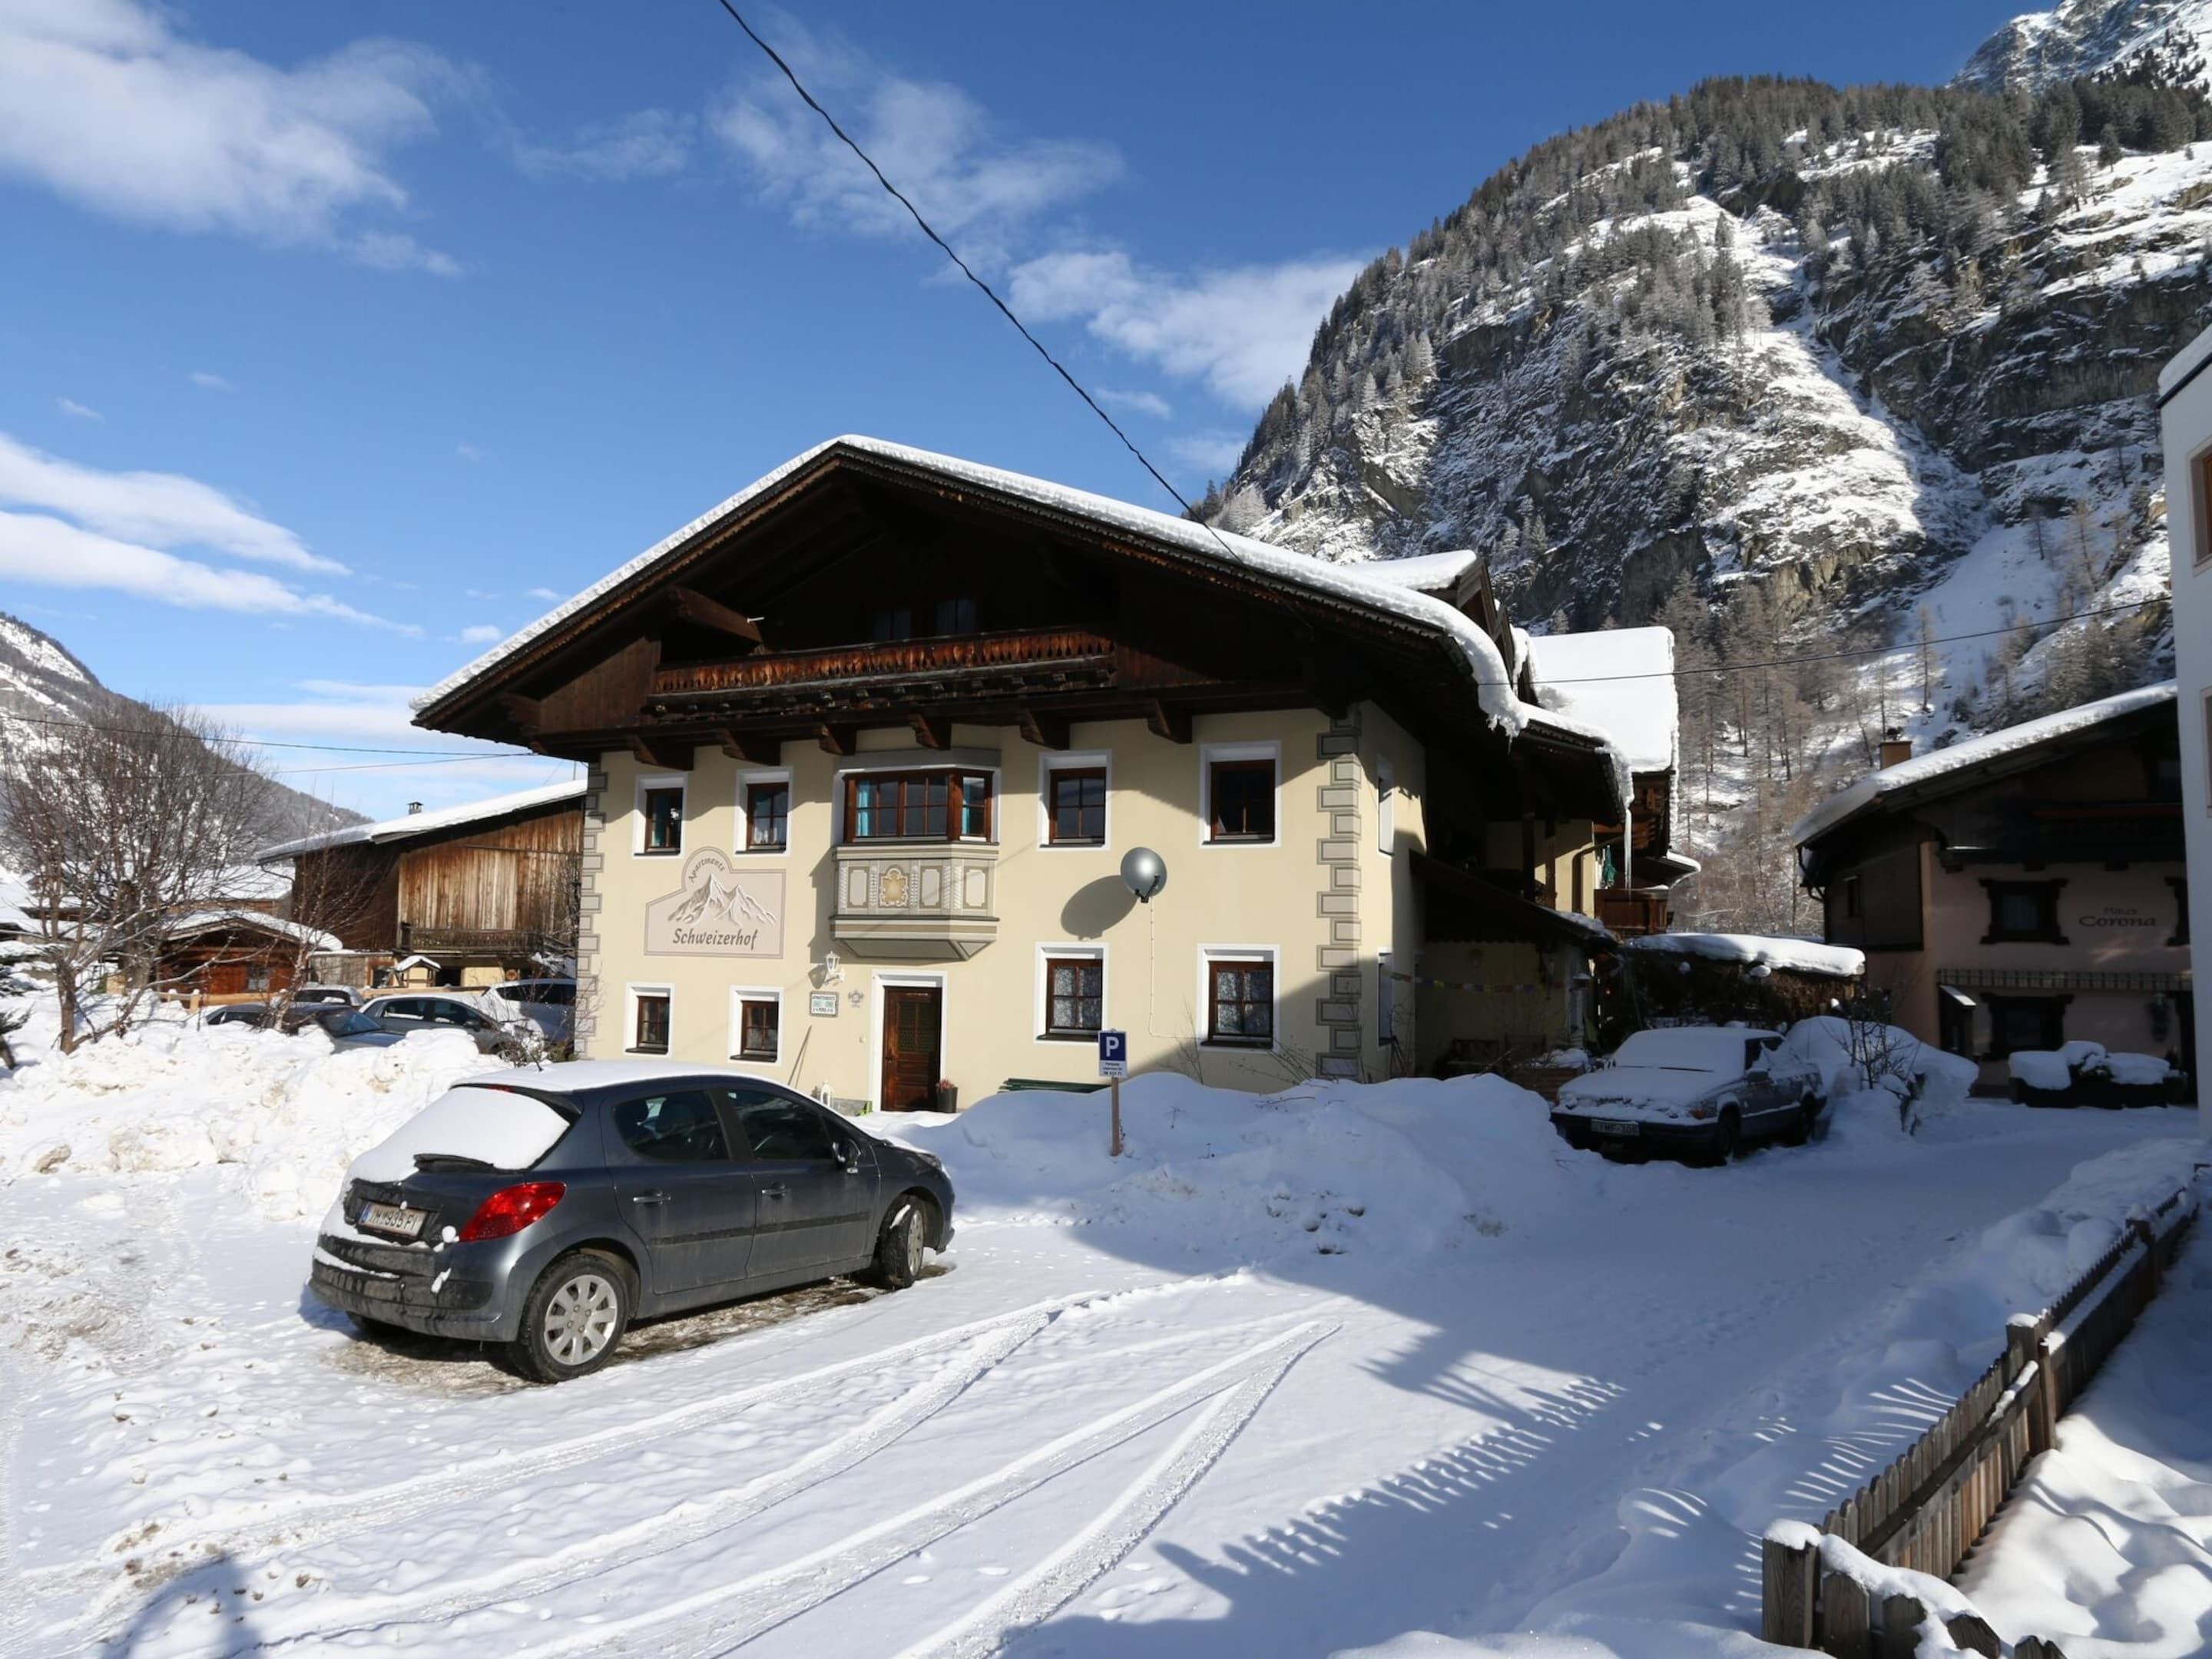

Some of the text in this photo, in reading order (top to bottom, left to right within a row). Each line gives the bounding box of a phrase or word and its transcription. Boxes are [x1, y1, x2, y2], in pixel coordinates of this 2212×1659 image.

[688, 857, 725, 883] Apartments
[2078, 916, 2157, 927] Corona
[673, 928, 758, 950] Schweizerhof
[1106, 1036, 1119, 1057] P
